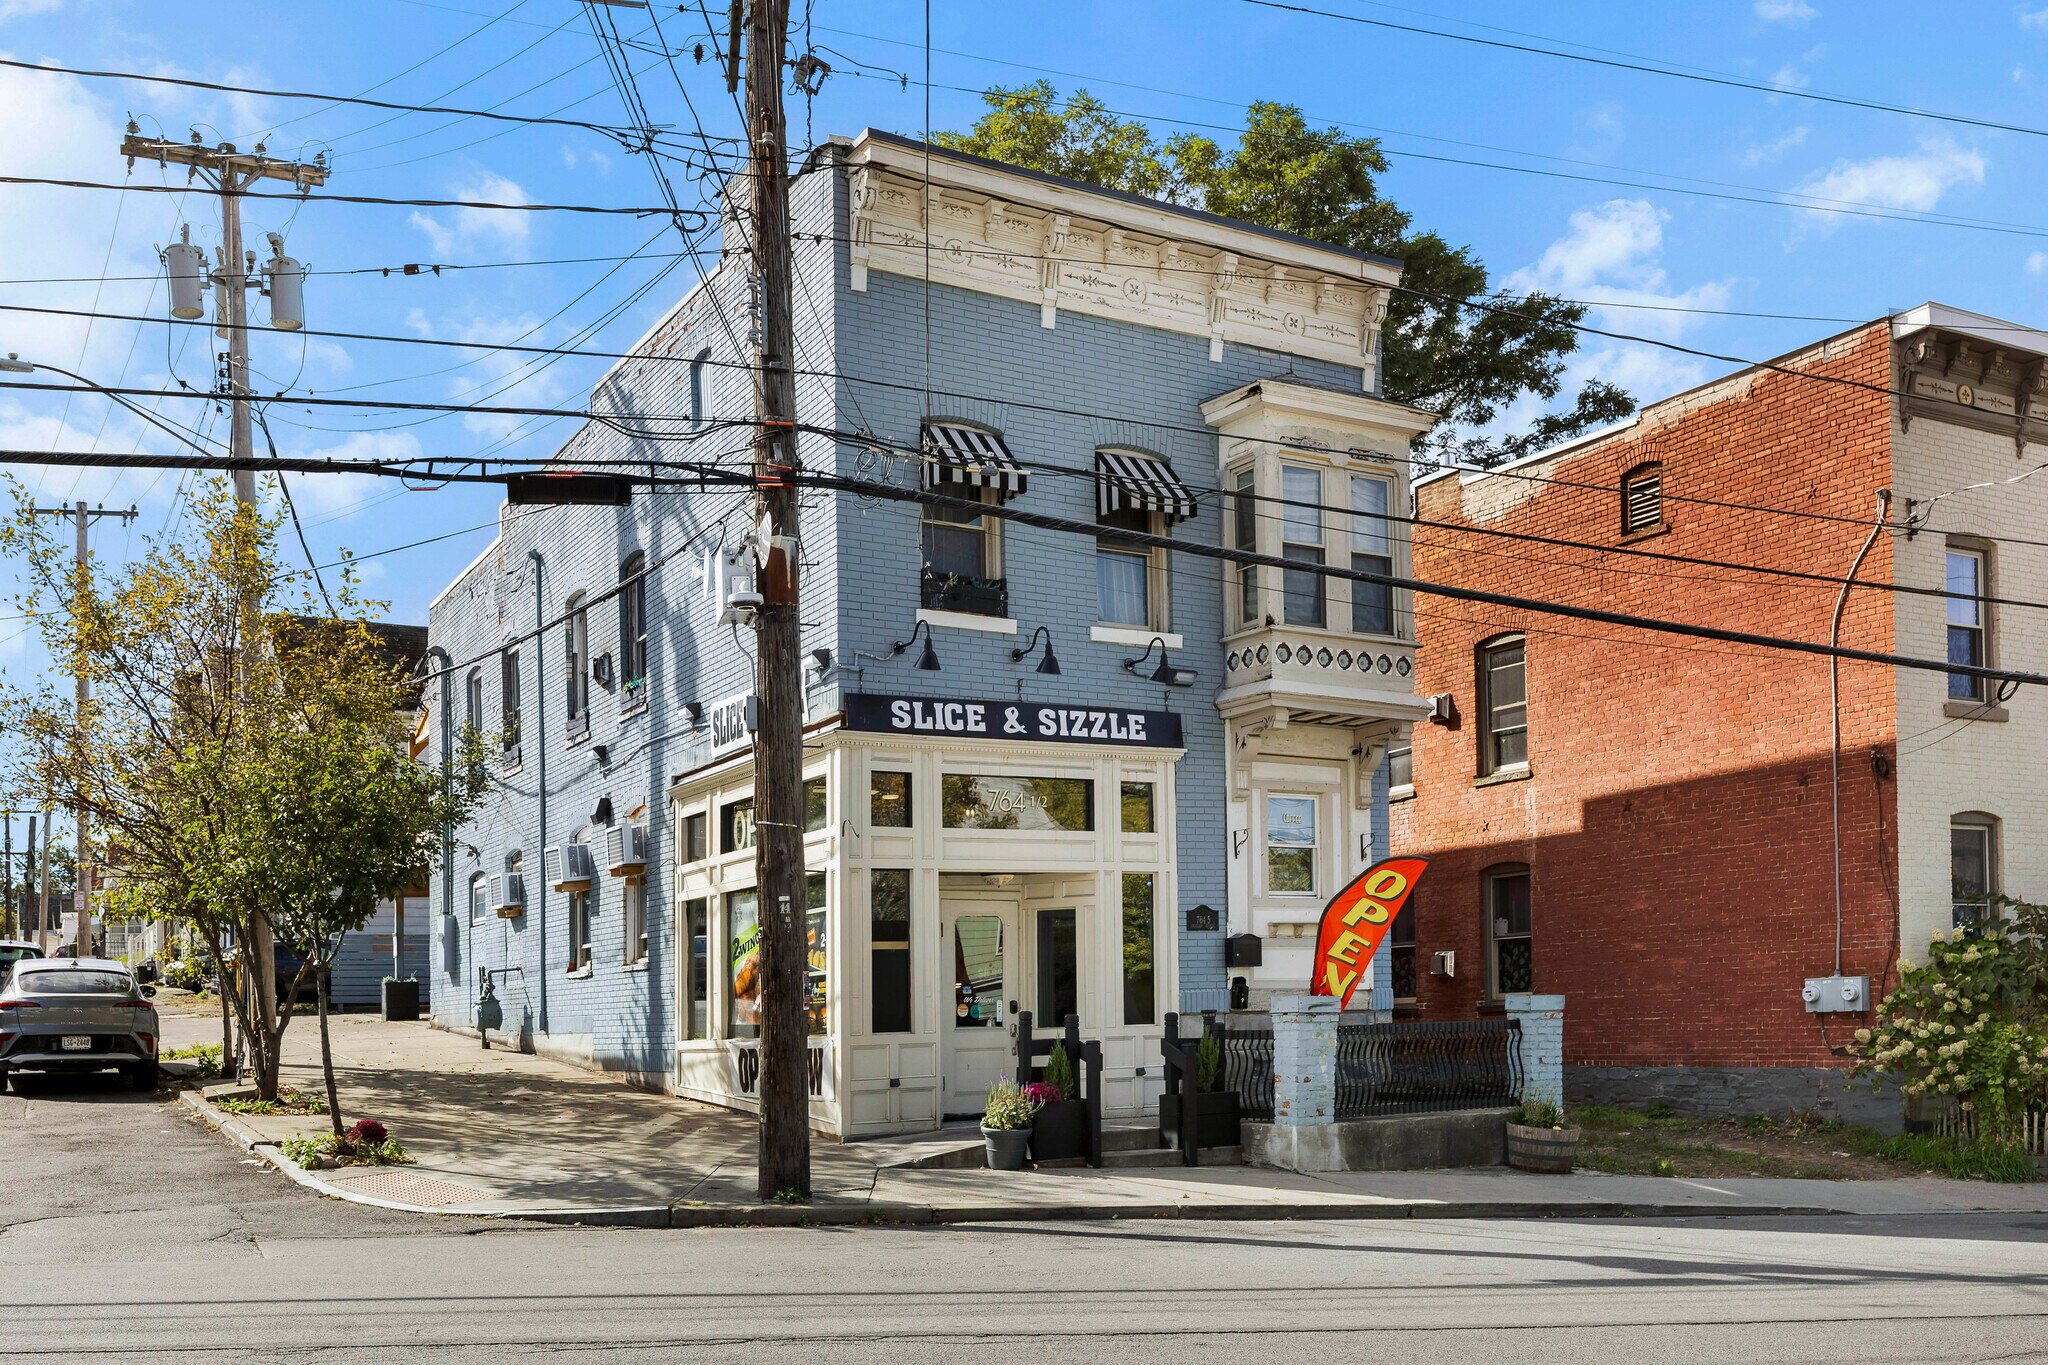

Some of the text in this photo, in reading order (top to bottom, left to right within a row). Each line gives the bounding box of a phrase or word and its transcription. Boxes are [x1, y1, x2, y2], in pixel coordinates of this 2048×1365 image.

[713, 699, 744, 748] SLICE
[891, 700, 1147, 741] SLICE & SIZZLE
[987, 789, 1048, 813] 764 1/2
[1321, 869, 1408, 1002] OPEN
